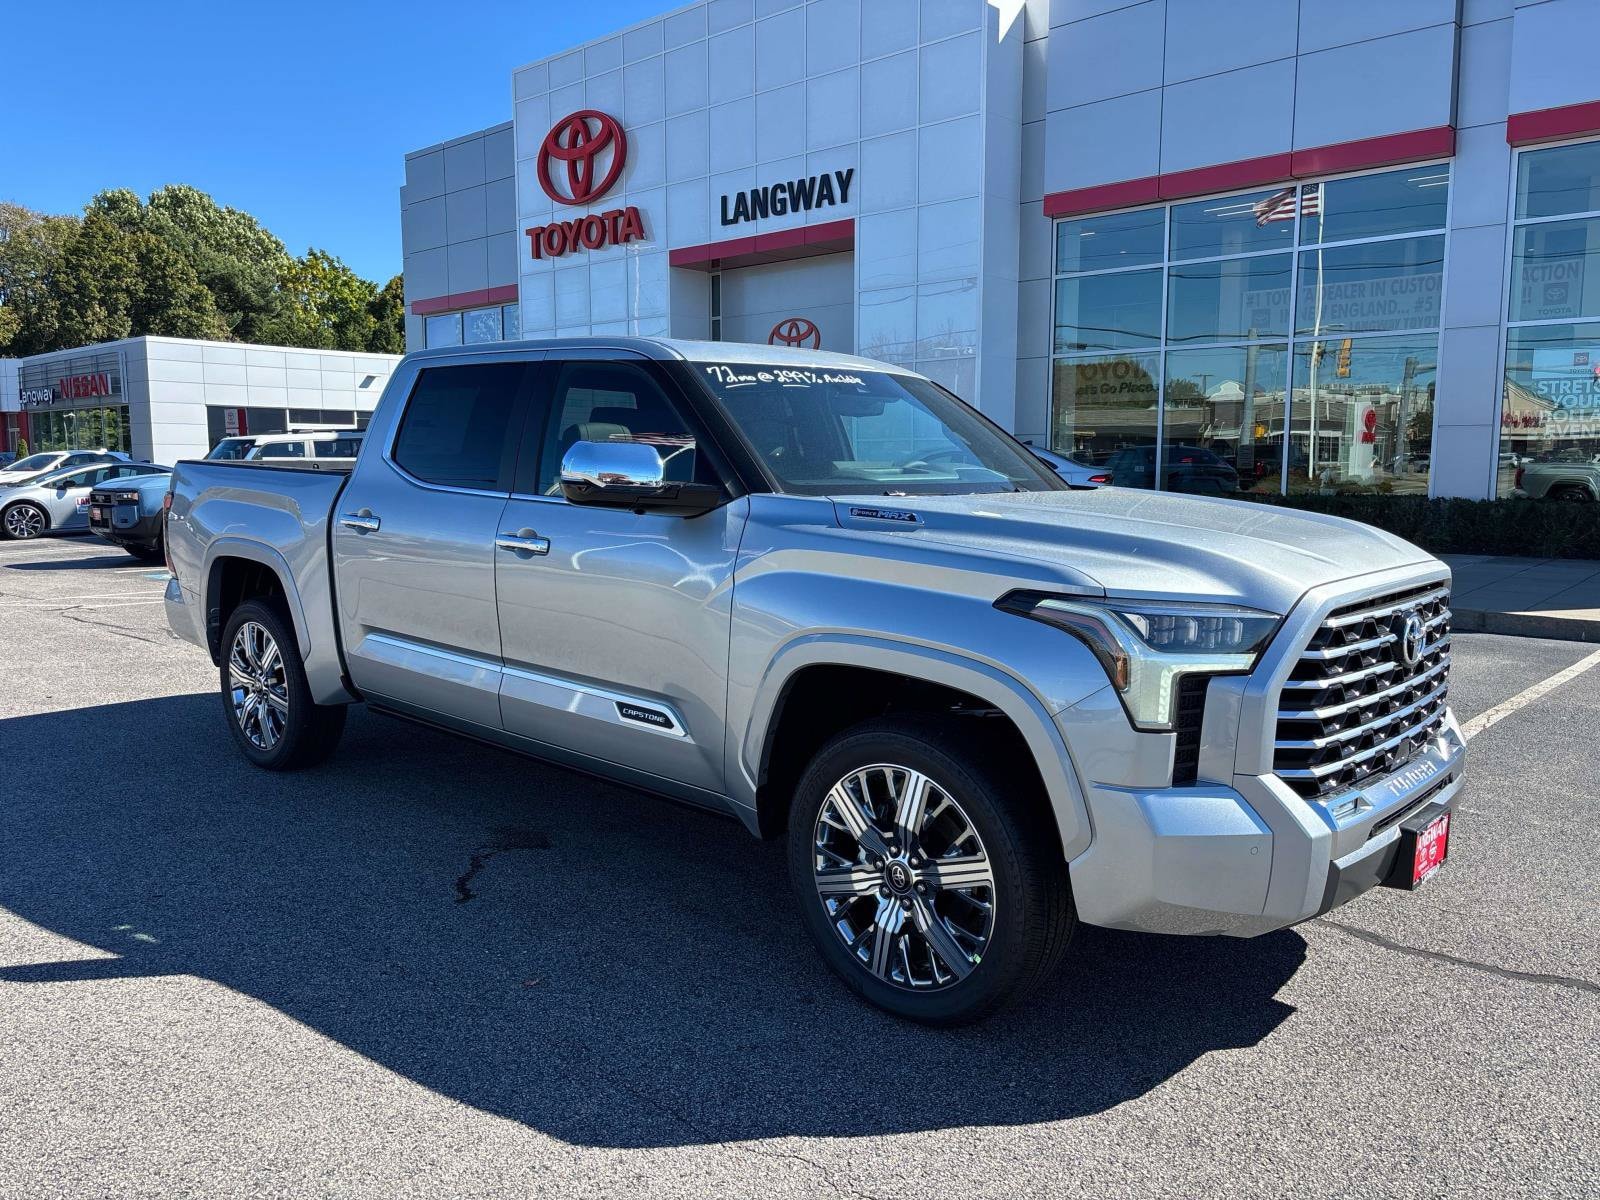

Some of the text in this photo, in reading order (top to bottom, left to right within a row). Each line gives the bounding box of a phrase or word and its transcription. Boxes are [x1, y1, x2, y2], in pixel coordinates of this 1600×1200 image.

[720, 168, 854, 226] LANGWAY
[525, 206, 646, 260] TOYOTA
[1370, 280, 1386, 298] IN
[1414, 296, 1434, 314] #5
[1537, 307, 1572, 315] TOYOTA
[60, 372, 110, 400] NISSAN
[622, 707, 666, 723] CAPSTONE
